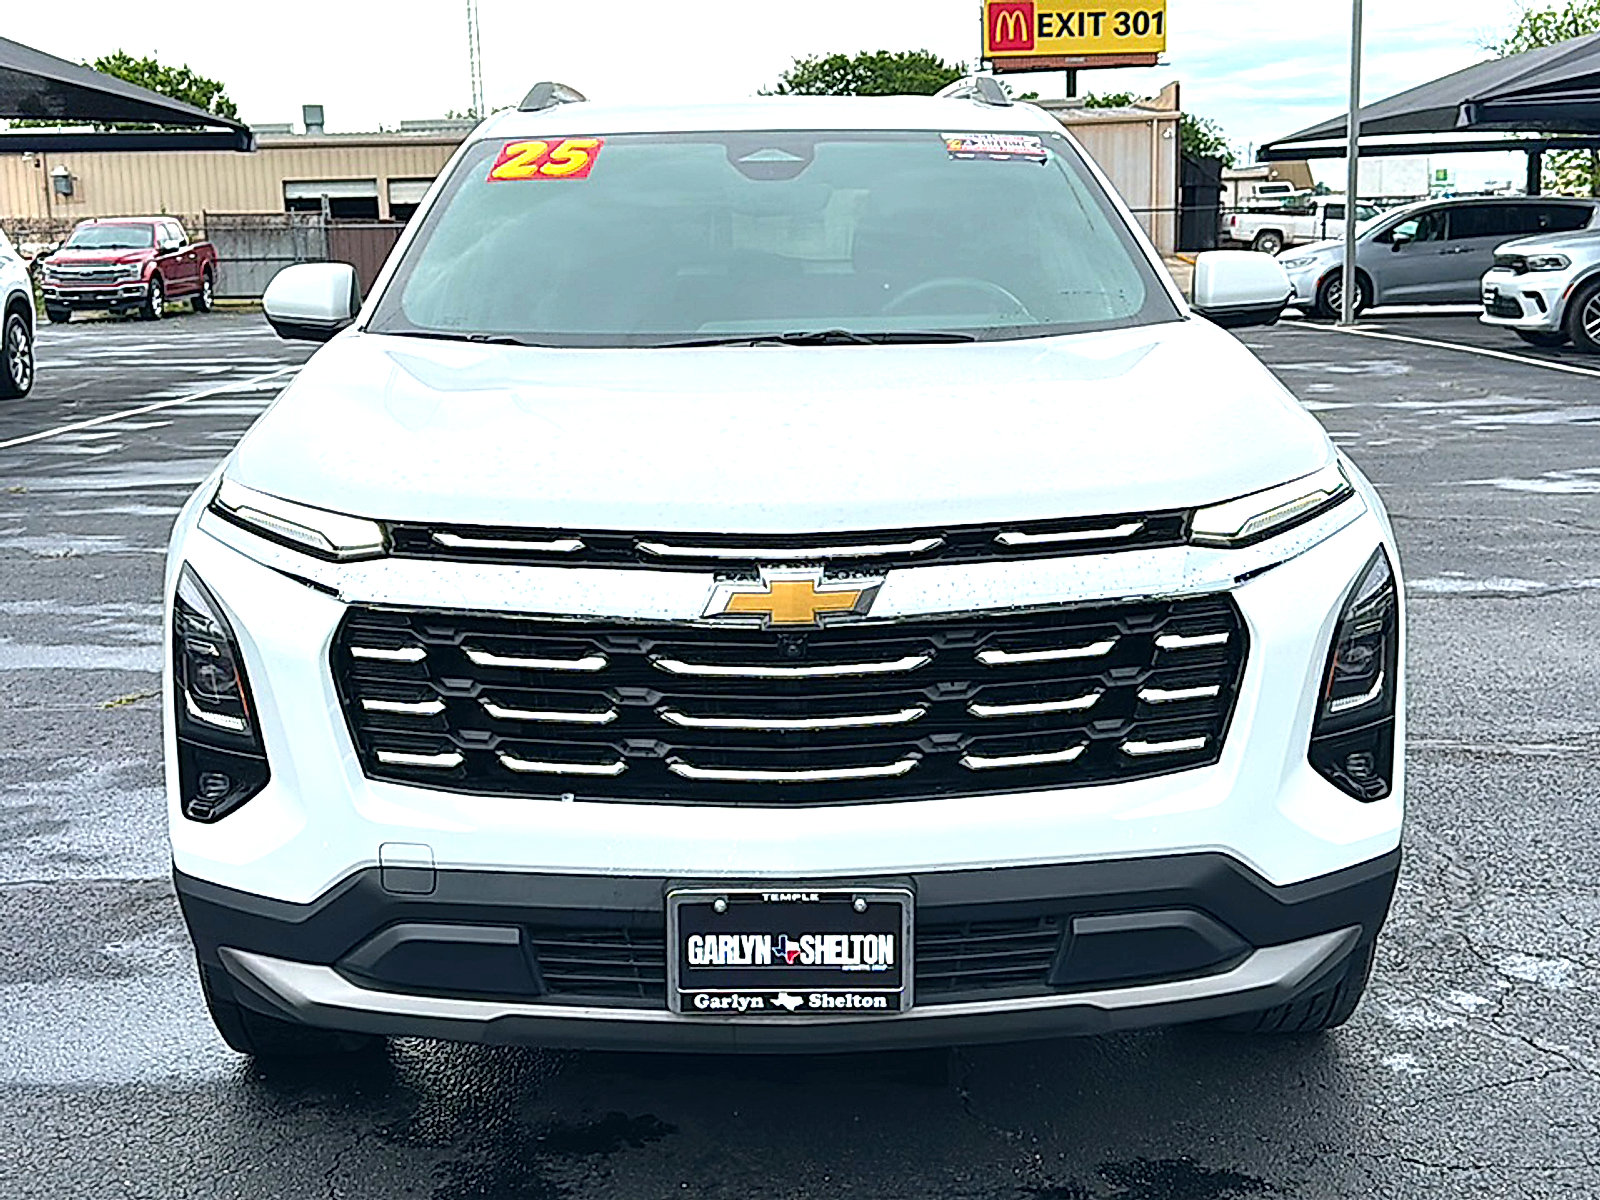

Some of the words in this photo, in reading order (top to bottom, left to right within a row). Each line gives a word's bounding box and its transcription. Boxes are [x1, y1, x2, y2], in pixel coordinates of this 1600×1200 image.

[1037, 12, 1107, 38] EXIT
[1113, 11, 1164, 37] 301
[490, 138, 600, 179] 25
[761, 892, 820, 902] TEMPLE
[687, 934, 773, 966] GARLYN
[799, 934, 895, 966] SHELTON
[693, 993, 765, 1012] Garlyn
[808, 993, 888, 1009] Shelton
